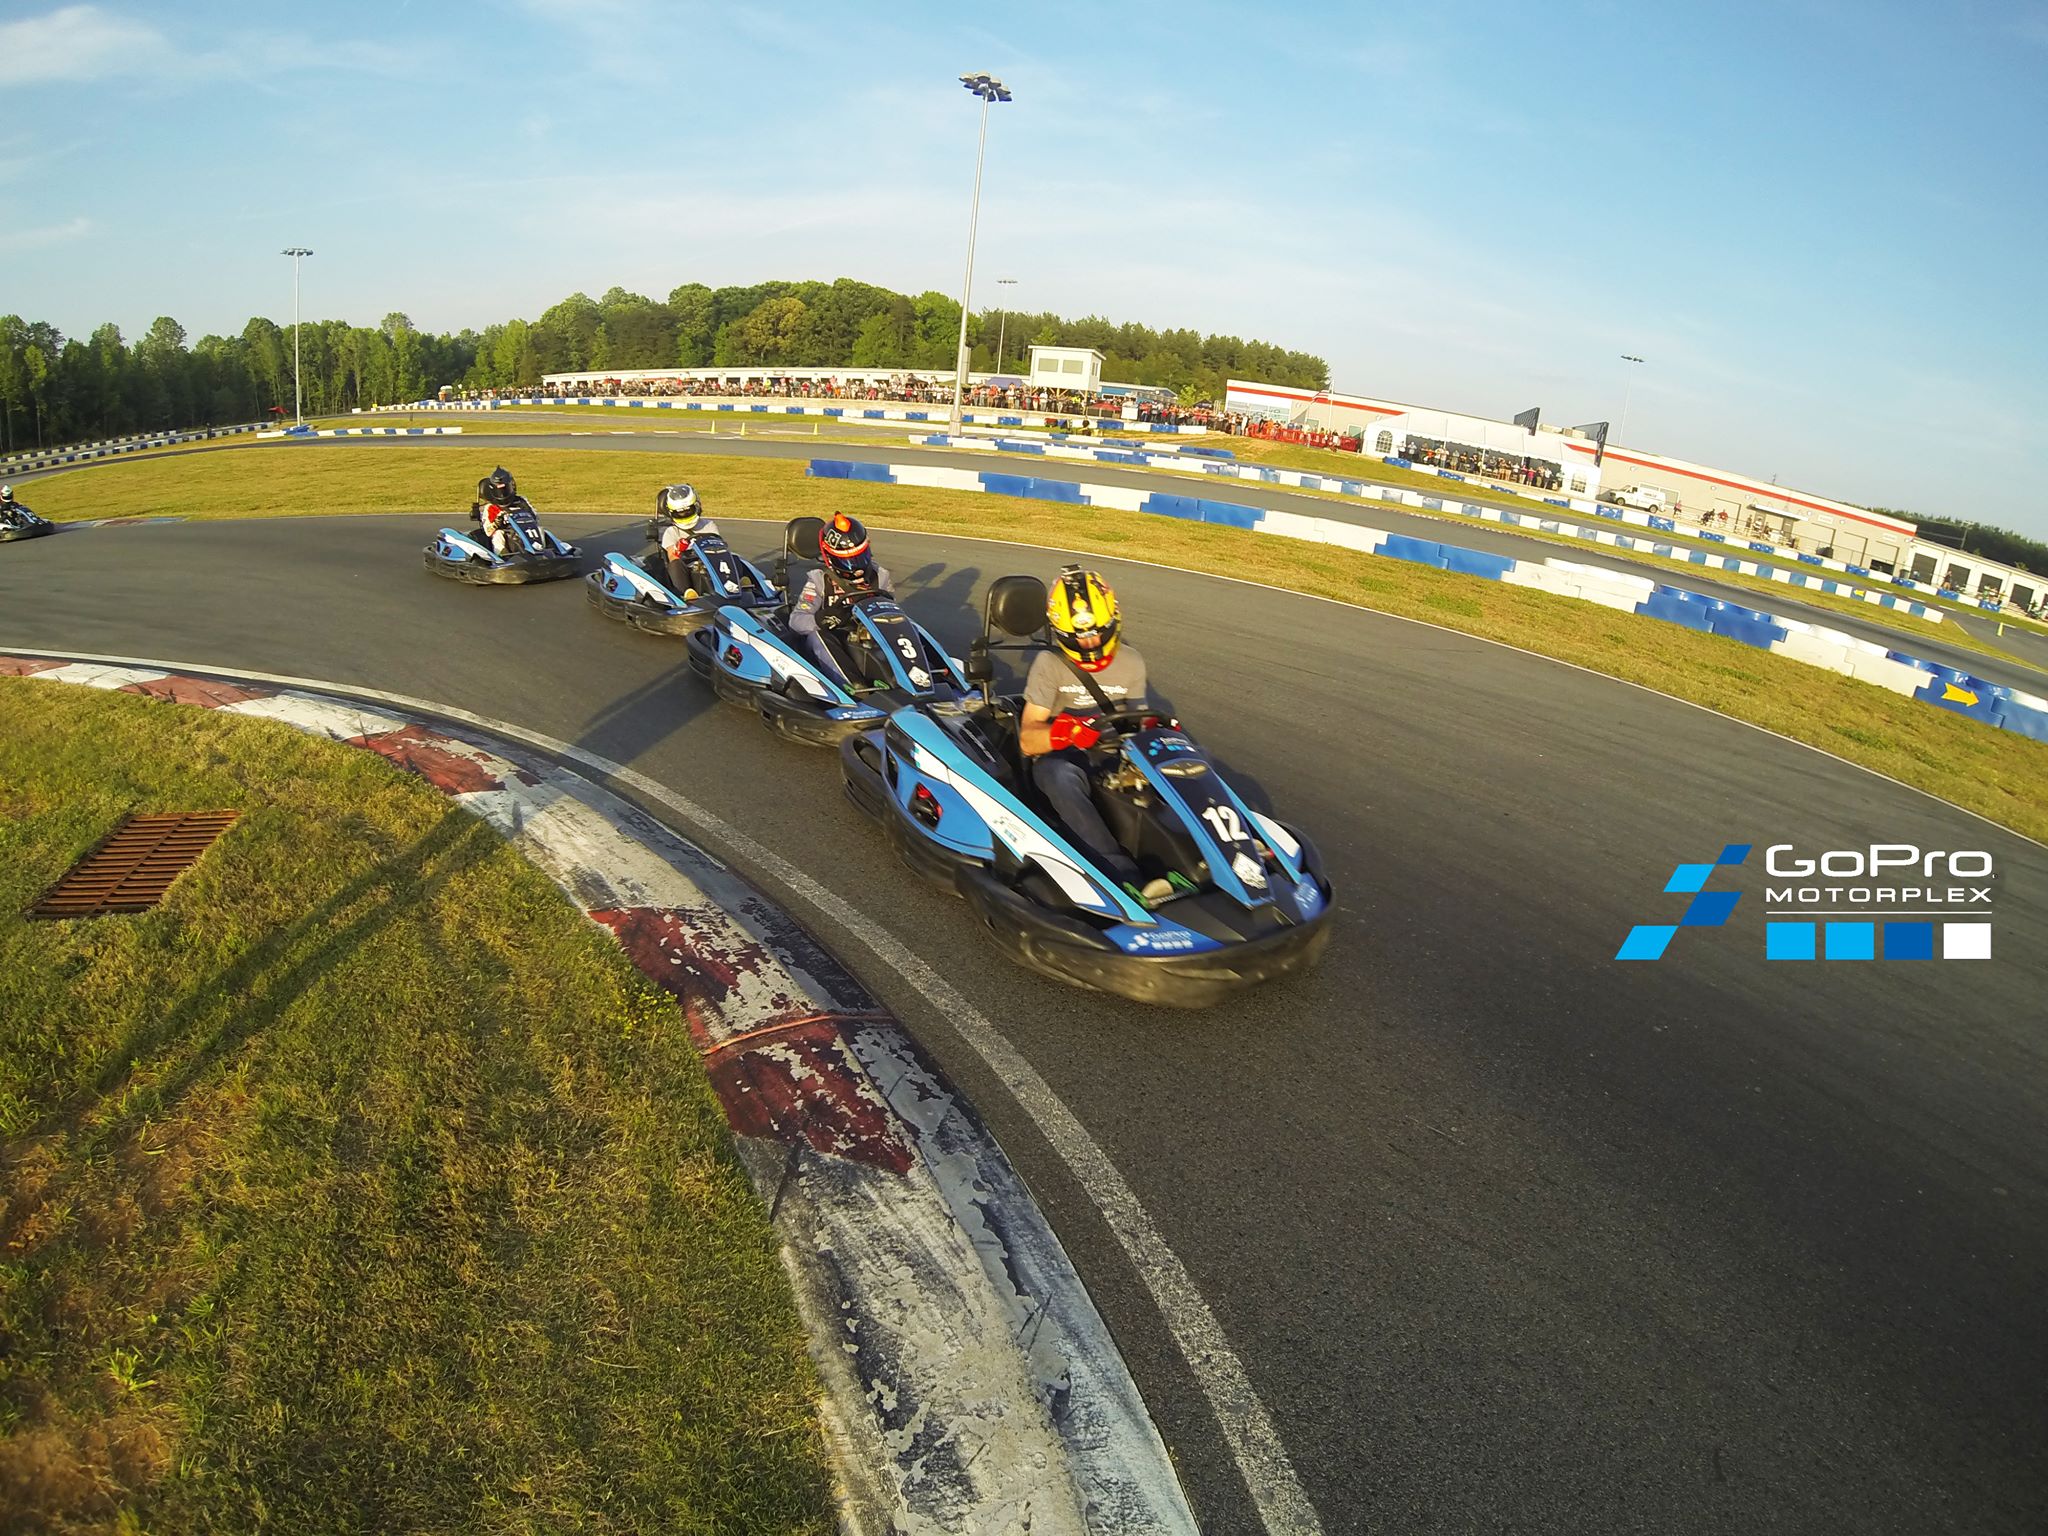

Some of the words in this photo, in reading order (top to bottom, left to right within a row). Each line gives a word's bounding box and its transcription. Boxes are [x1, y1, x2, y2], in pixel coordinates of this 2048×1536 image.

[525, 529, 539, 538] 11
[719, 561, 731, 574] 4
[897, 638, 917, 659] 3
[1202, 805, 1249, 842] 12
